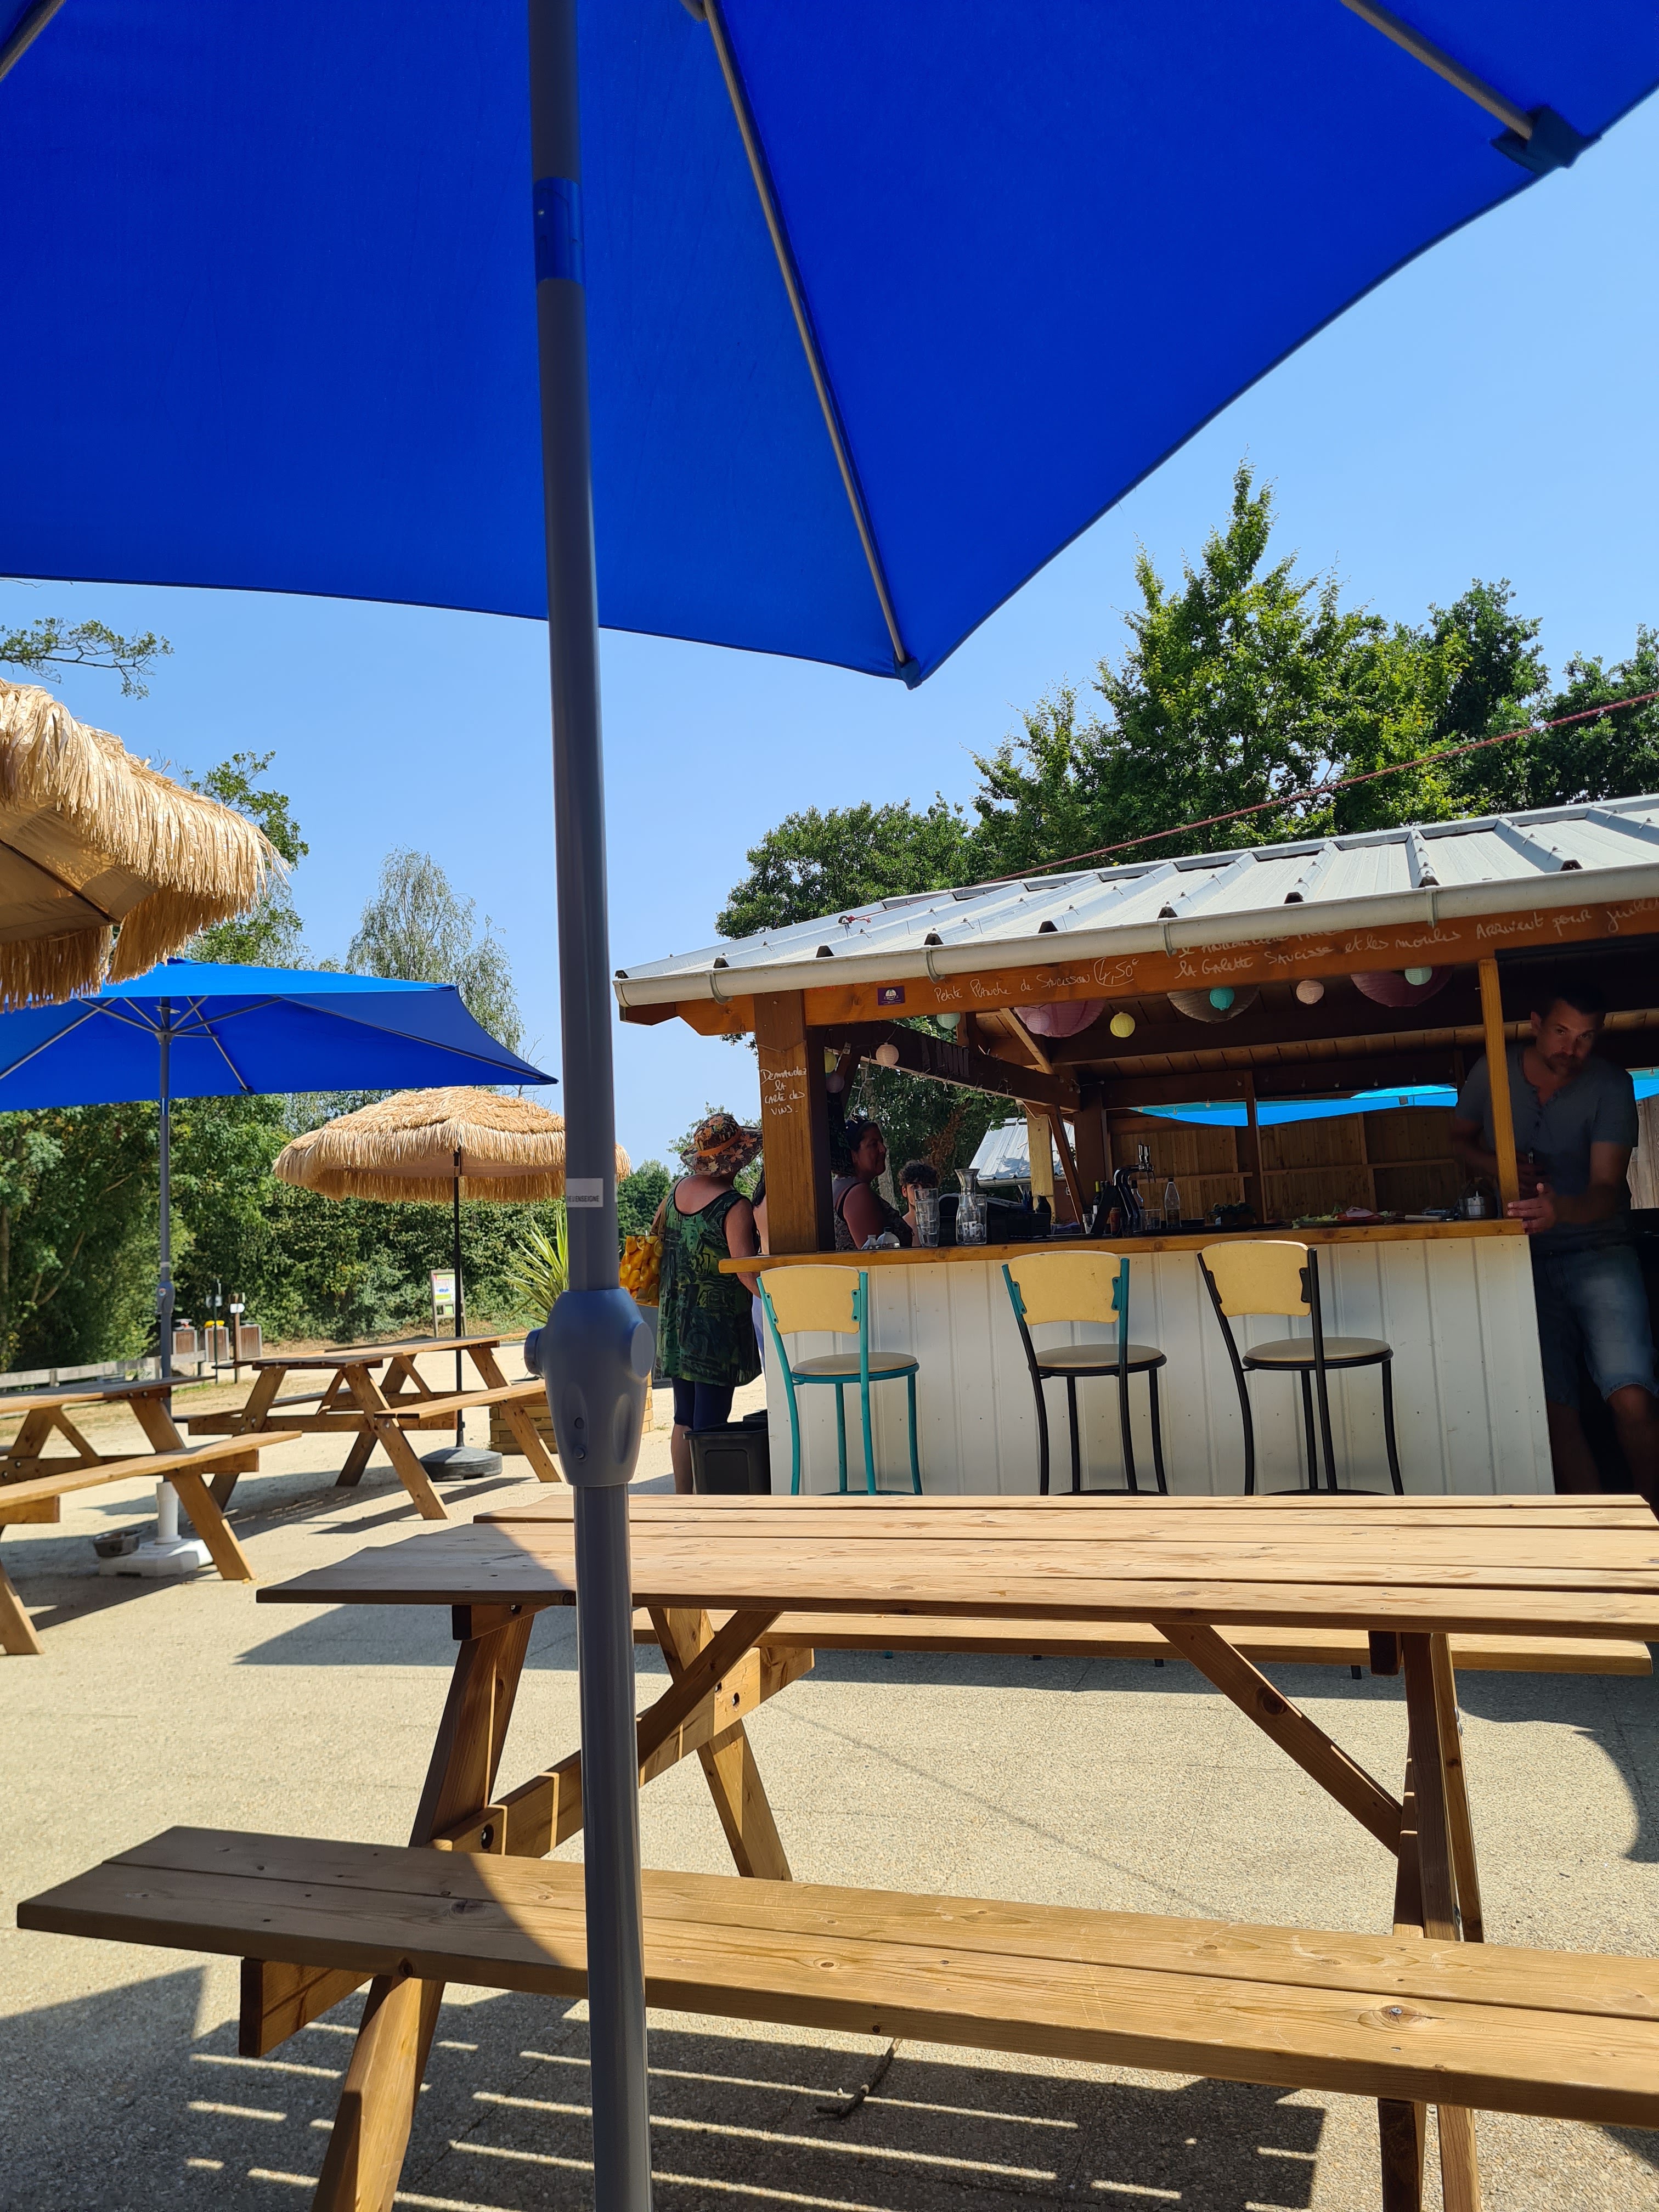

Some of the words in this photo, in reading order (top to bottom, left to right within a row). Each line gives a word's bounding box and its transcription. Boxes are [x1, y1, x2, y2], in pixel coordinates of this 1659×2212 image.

[1395, 928, 1462, 949] moules
[934, 985, 963, 1003] Petite
[1020, 979, 1034, 991] de
